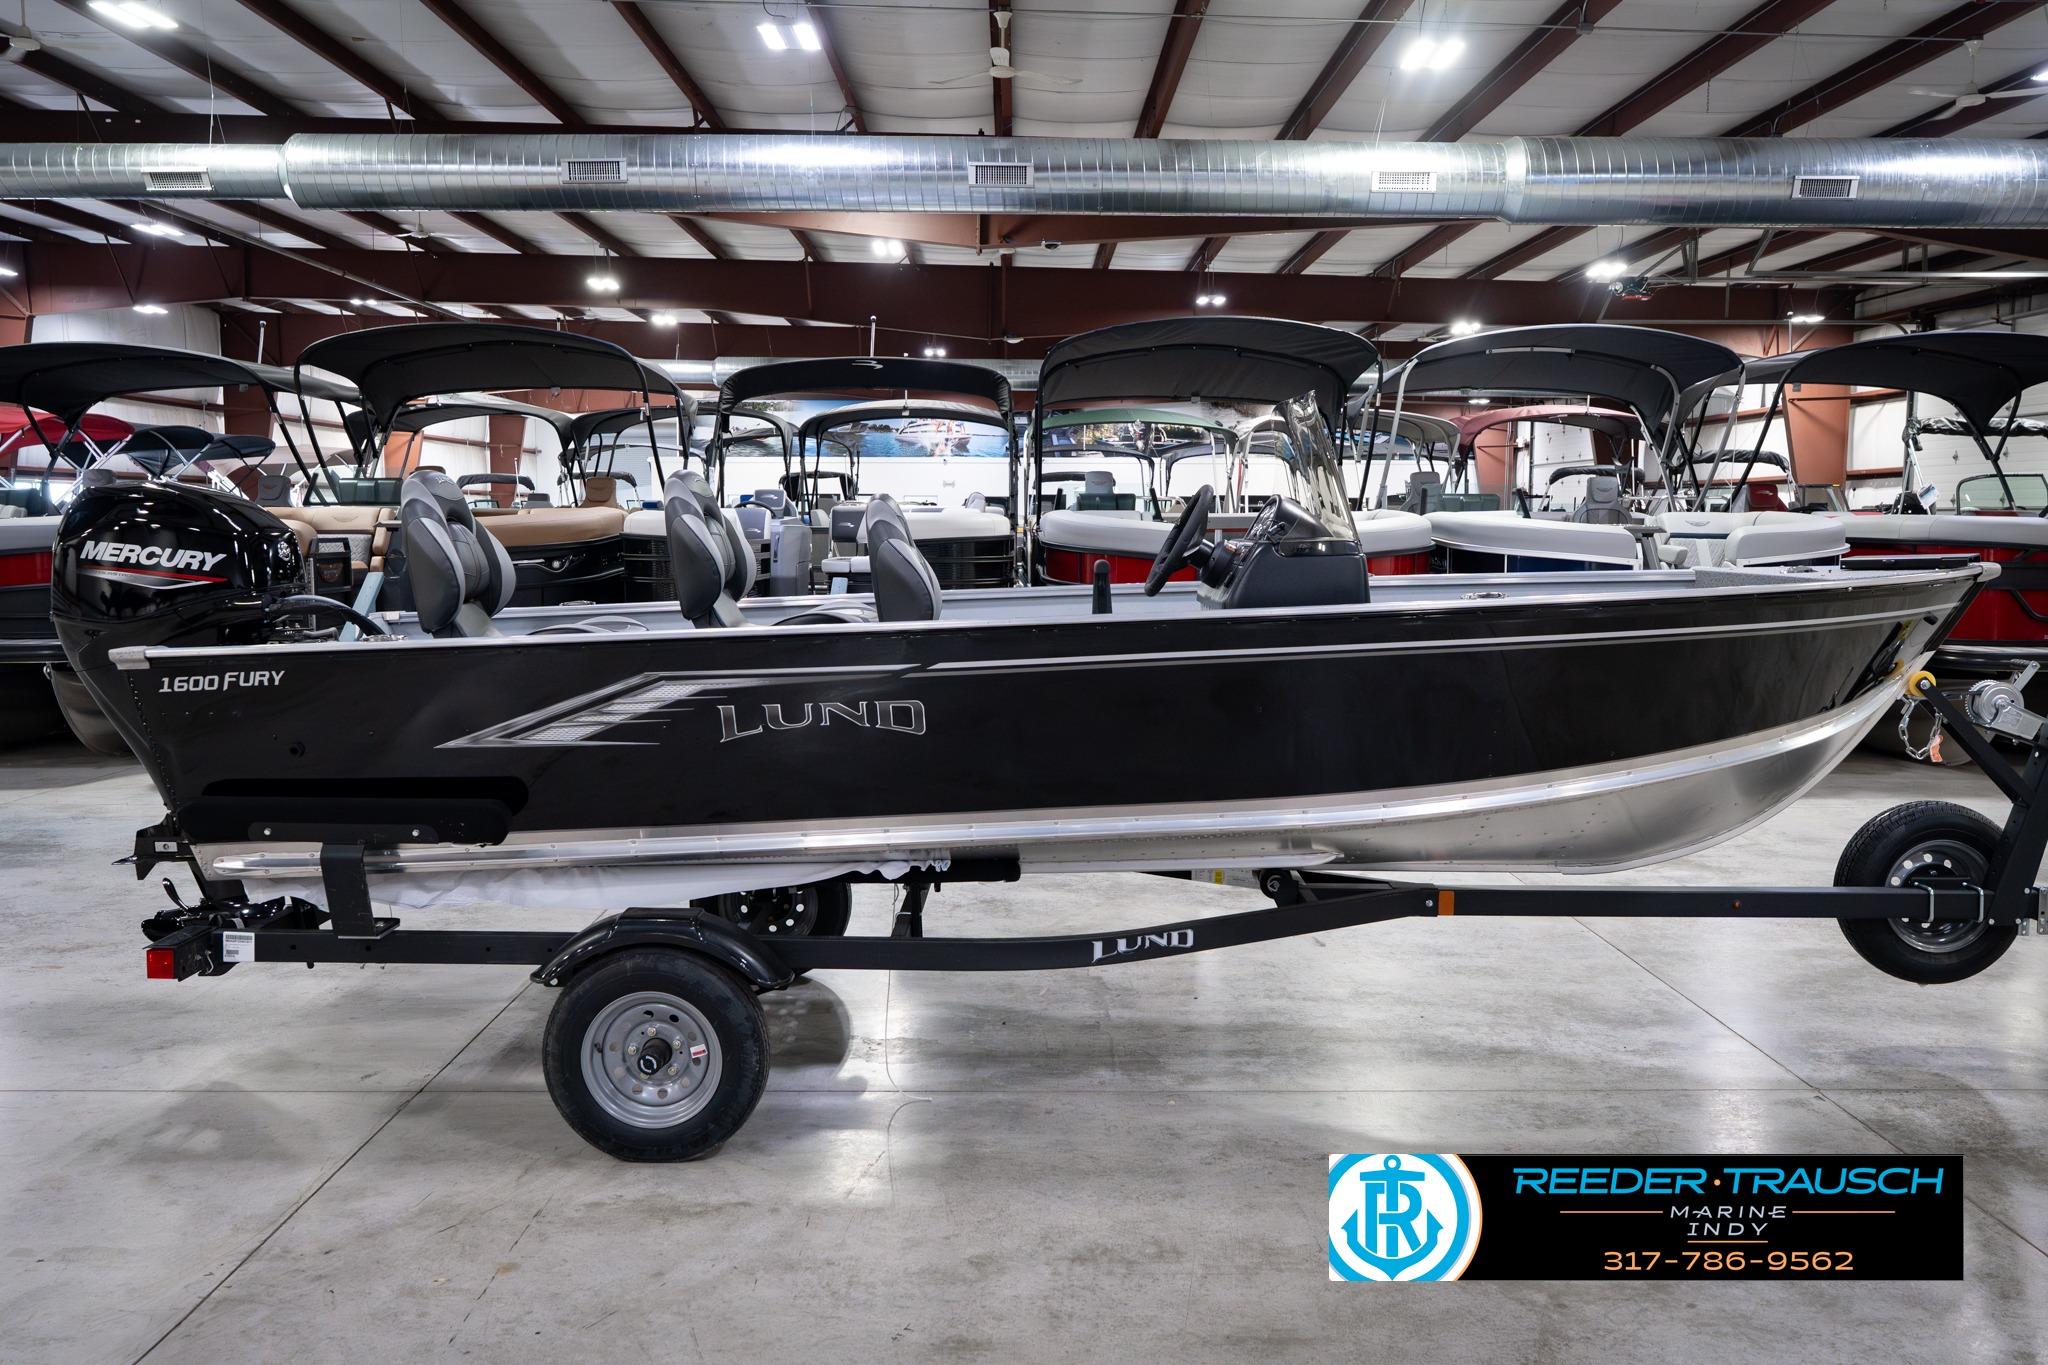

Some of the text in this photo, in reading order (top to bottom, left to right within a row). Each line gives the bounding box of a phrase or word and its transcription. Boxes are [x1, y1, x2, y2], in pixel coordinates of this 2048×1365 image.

[80, 540, 227, 572] MERCURY
[158, 670, 286, 693] 1600 FURY
[716, 699, 927, 743] LUND
[1091, 928, 1194, 964] LUND
